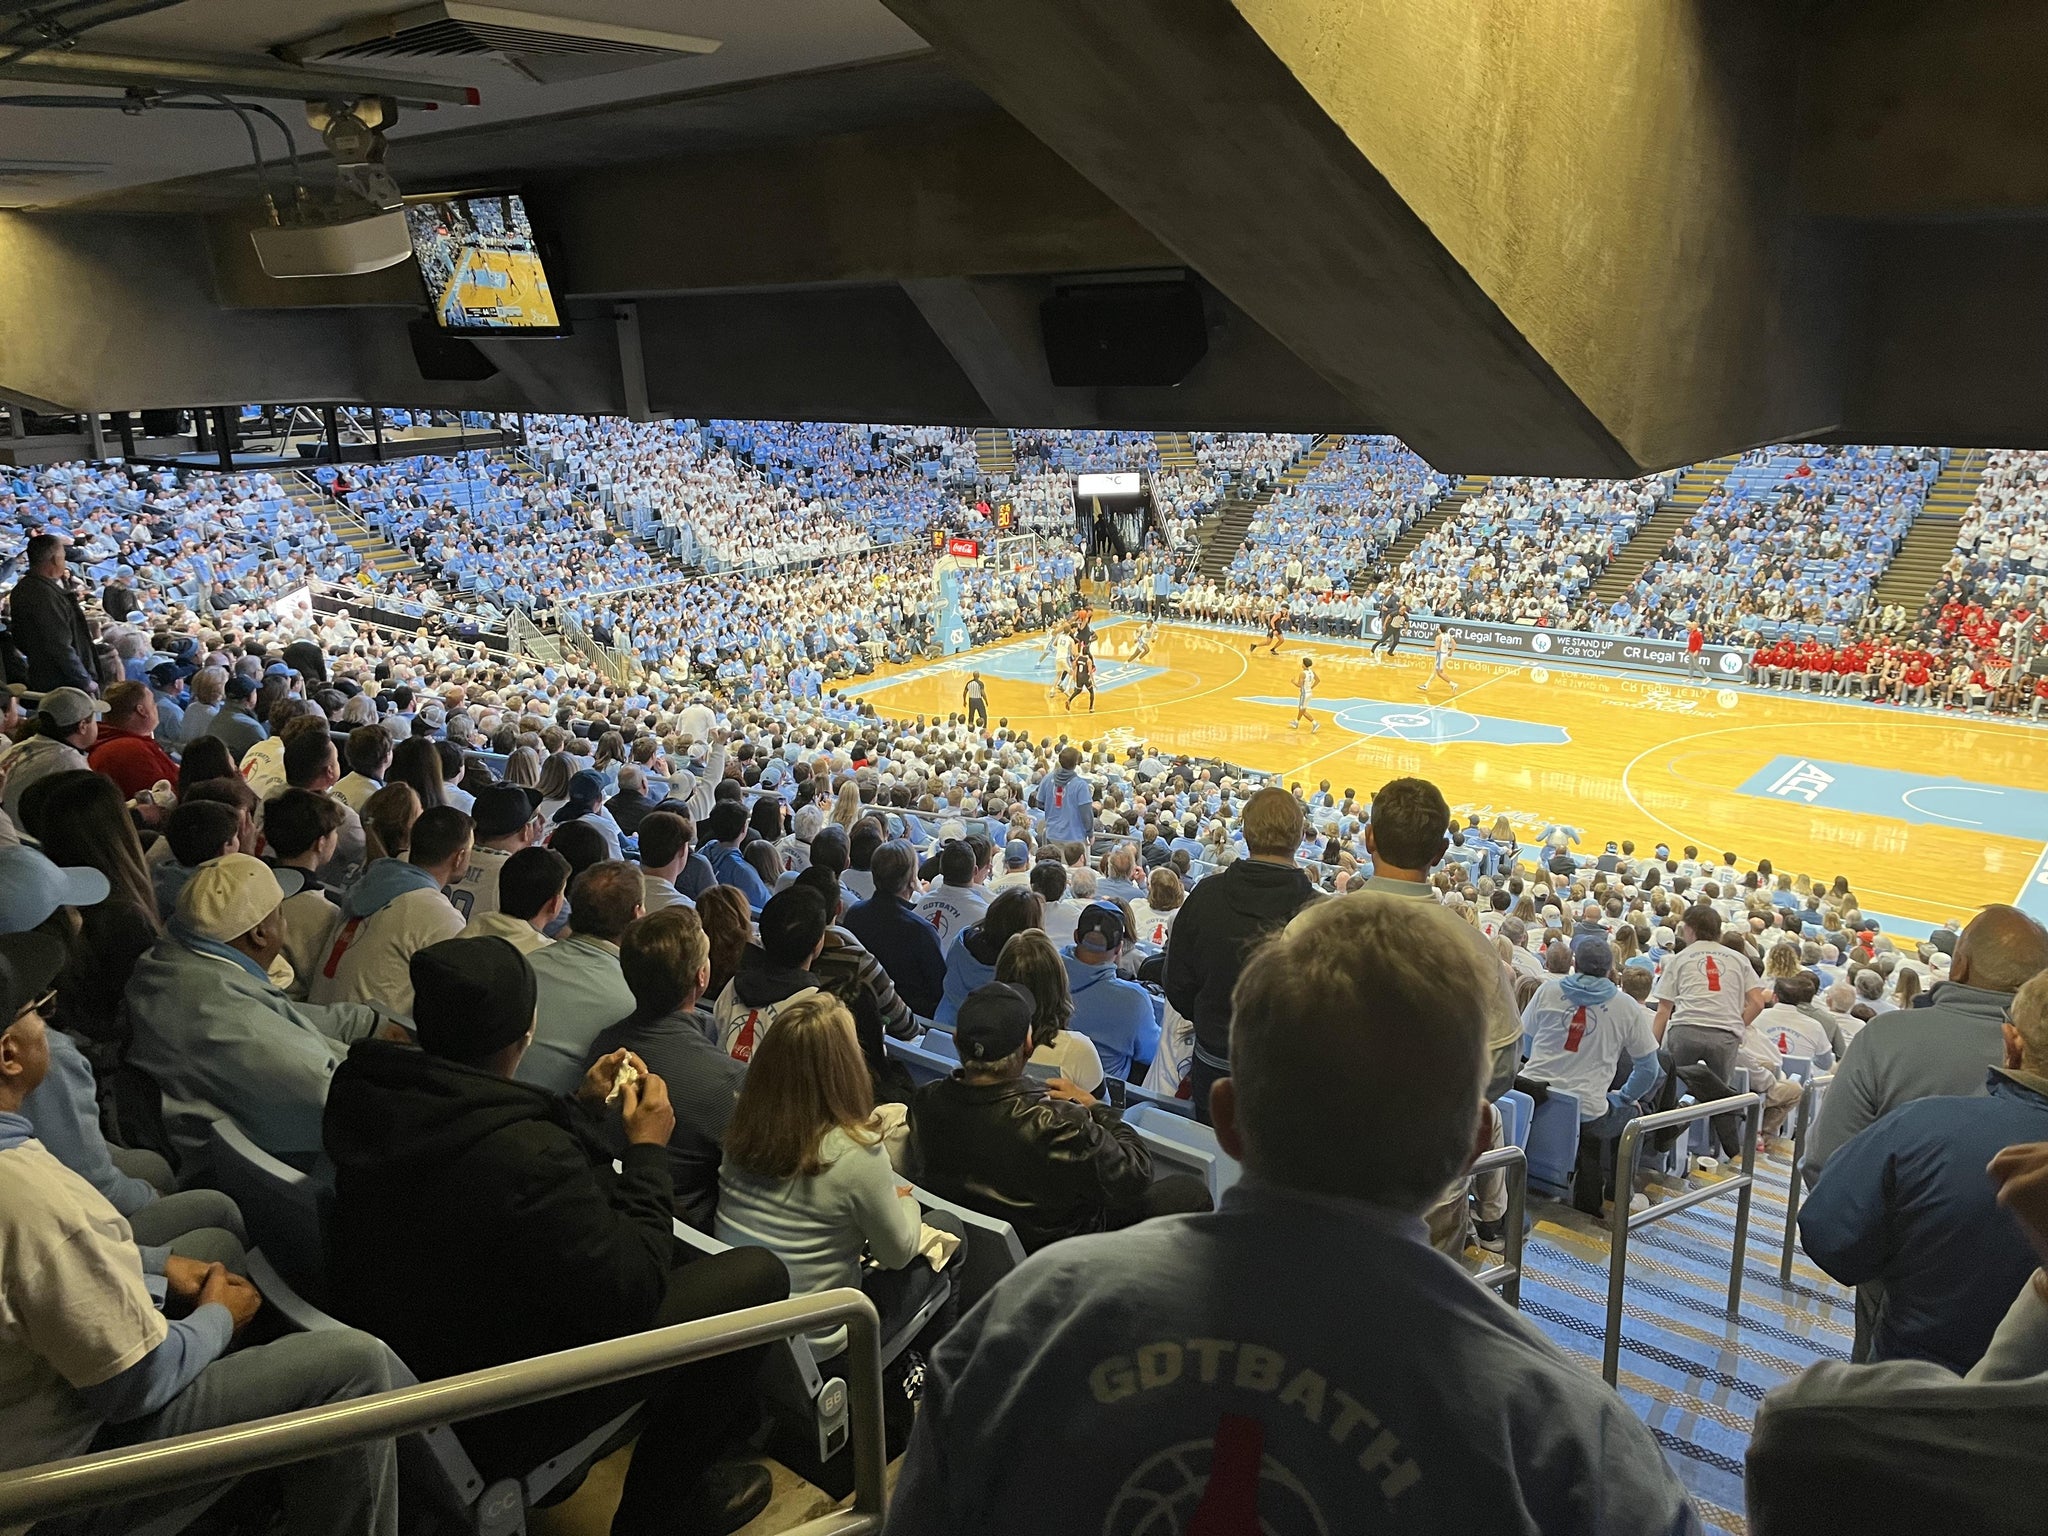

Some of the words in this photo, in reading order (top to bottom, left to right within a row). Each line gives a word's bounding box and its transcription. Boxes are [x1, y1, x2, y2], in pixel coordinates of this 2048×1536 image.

[1447, 627, 1463, 639] CR
[1464, 629, 1492, 644] Legal
[1494, 632, 1523, 646] Team
[1557, 636, 1571, 646] WE
[1572, 638, 1600, 649] STAND
[1601, 640, 1614, 650] UP
[1562, 646, 1581, 656] FOR
[1623, 646, 1640, 659] CR
[1643, 648, 1676, 664] Legal
[1678, 652, 1711, 667] Tem
